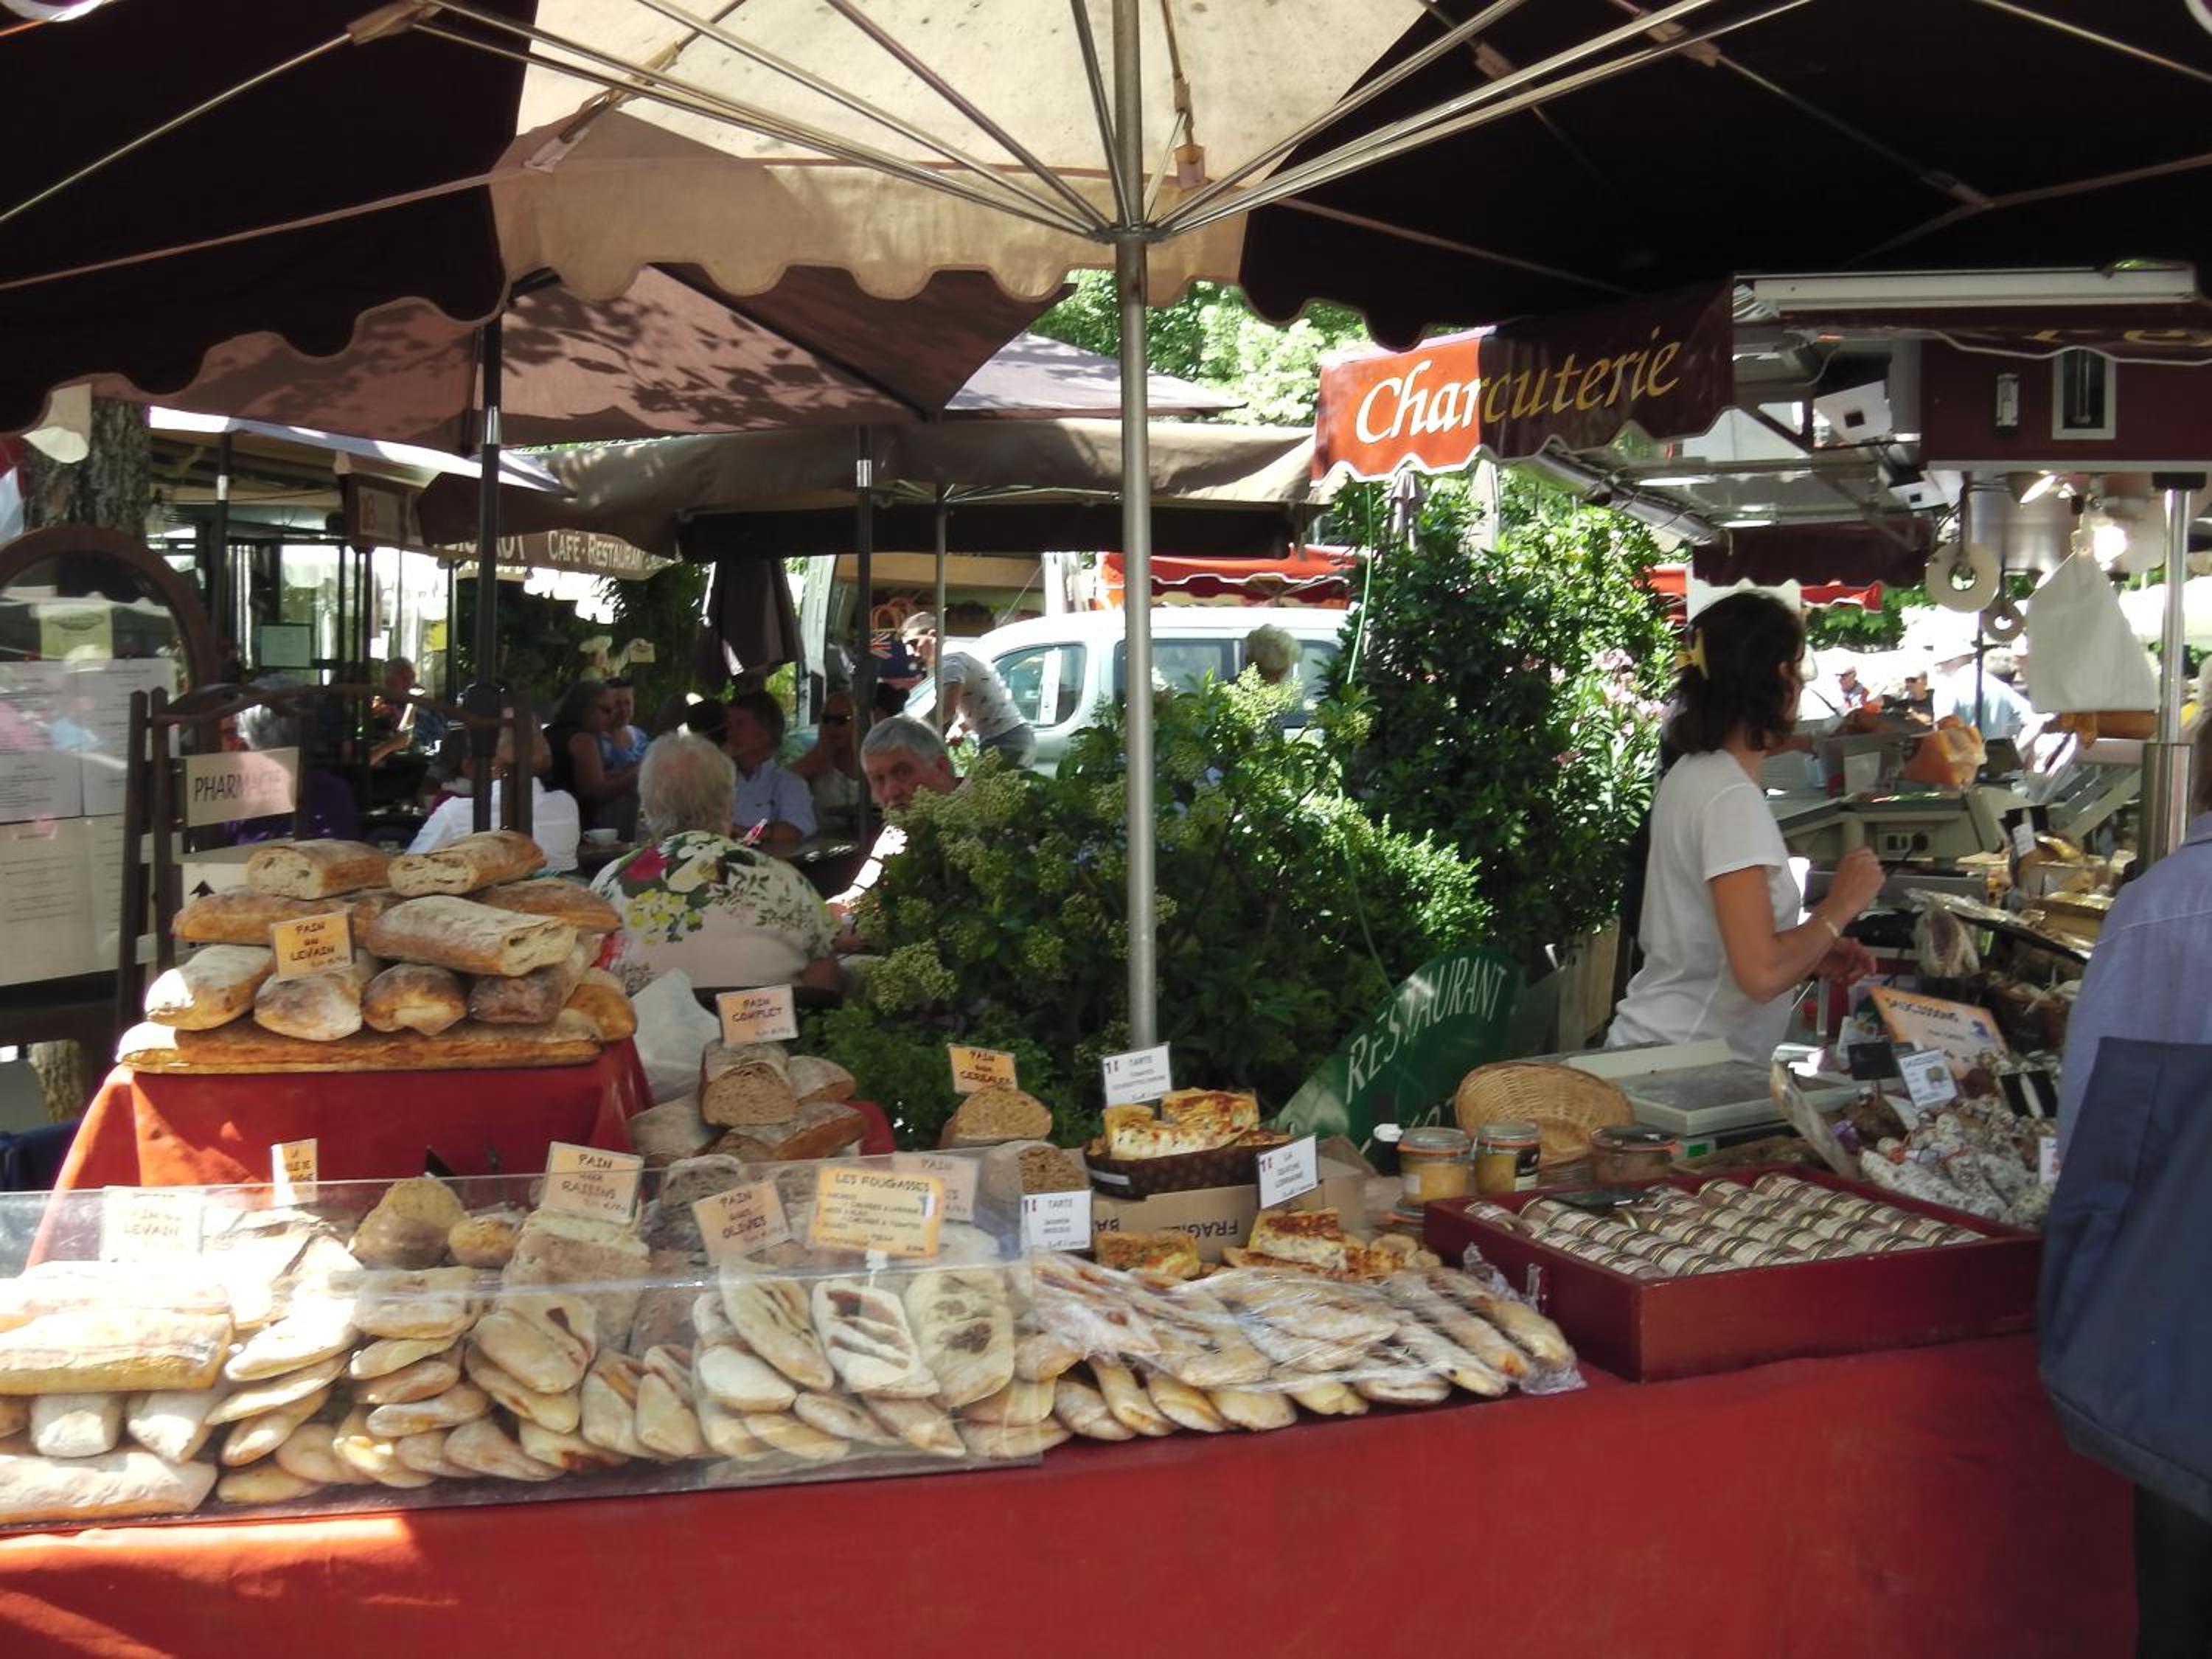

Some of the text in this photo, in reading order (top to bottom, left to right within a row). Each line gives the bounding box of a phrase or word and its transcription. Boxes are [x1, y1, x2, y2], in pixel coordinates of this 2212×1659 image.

[1356, 327, 1681, 445] Charcuterie
[295, 921, 326, 934] PAIN
[289, 945, 335, 961] LEVAIN
[742, 998, 770, 1010] PAIN
[731, 1006, 783, 1023] COMPLET
[578, 1153, 613, 1169] PAIN
[561, 1180, 616, 1200] RAISINS
[835, 1172, 931, 1192] LES FOUGASSES
[720, 1191, 752, 1208] PAIN
[722, 1214, 768, 1239] OLIVES
[1095, 1217, 1121, 1233] BA
